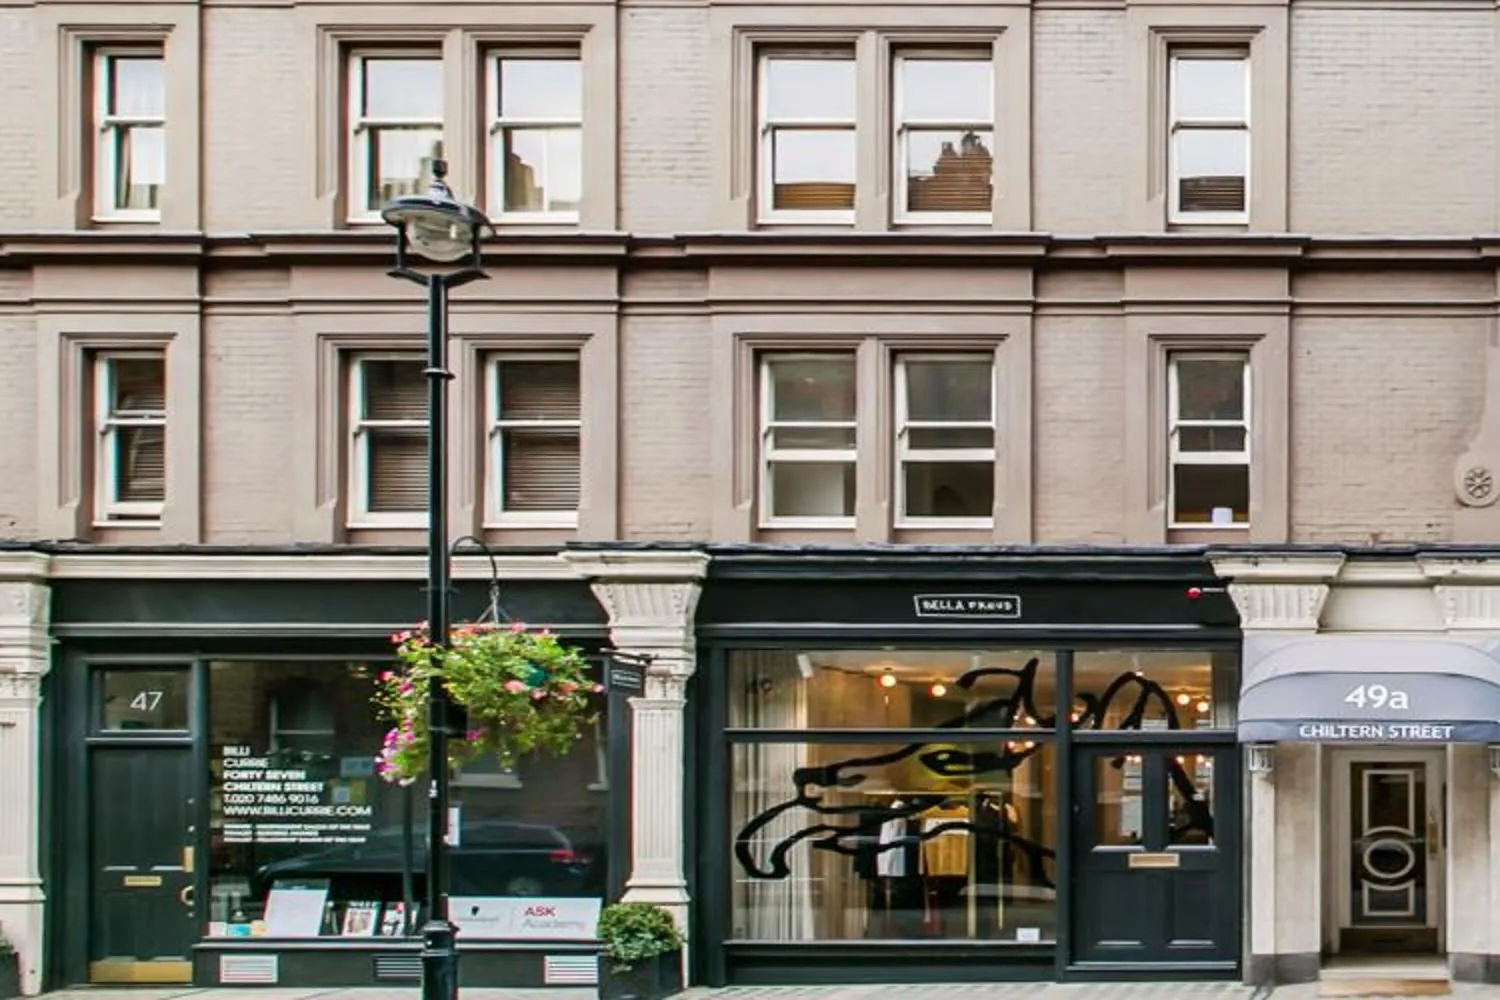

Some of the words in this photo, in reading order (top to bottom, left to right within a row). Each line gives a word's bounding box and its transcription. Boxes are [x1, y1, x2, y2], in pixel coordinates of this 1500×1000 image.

[923, 600, 965, 611] BELLA
[130, 691, 164, 711] 47
[1344, 684, 1409, 710] 49a
[1299, 724, 1384, 739] CHILTERN
[1387, 724, 1455, 739] STREET
[223, 770, 264, 780] FORTY
[265, 770, 306, 780] SEVEN
[524, 906, 557, 917] ASK
